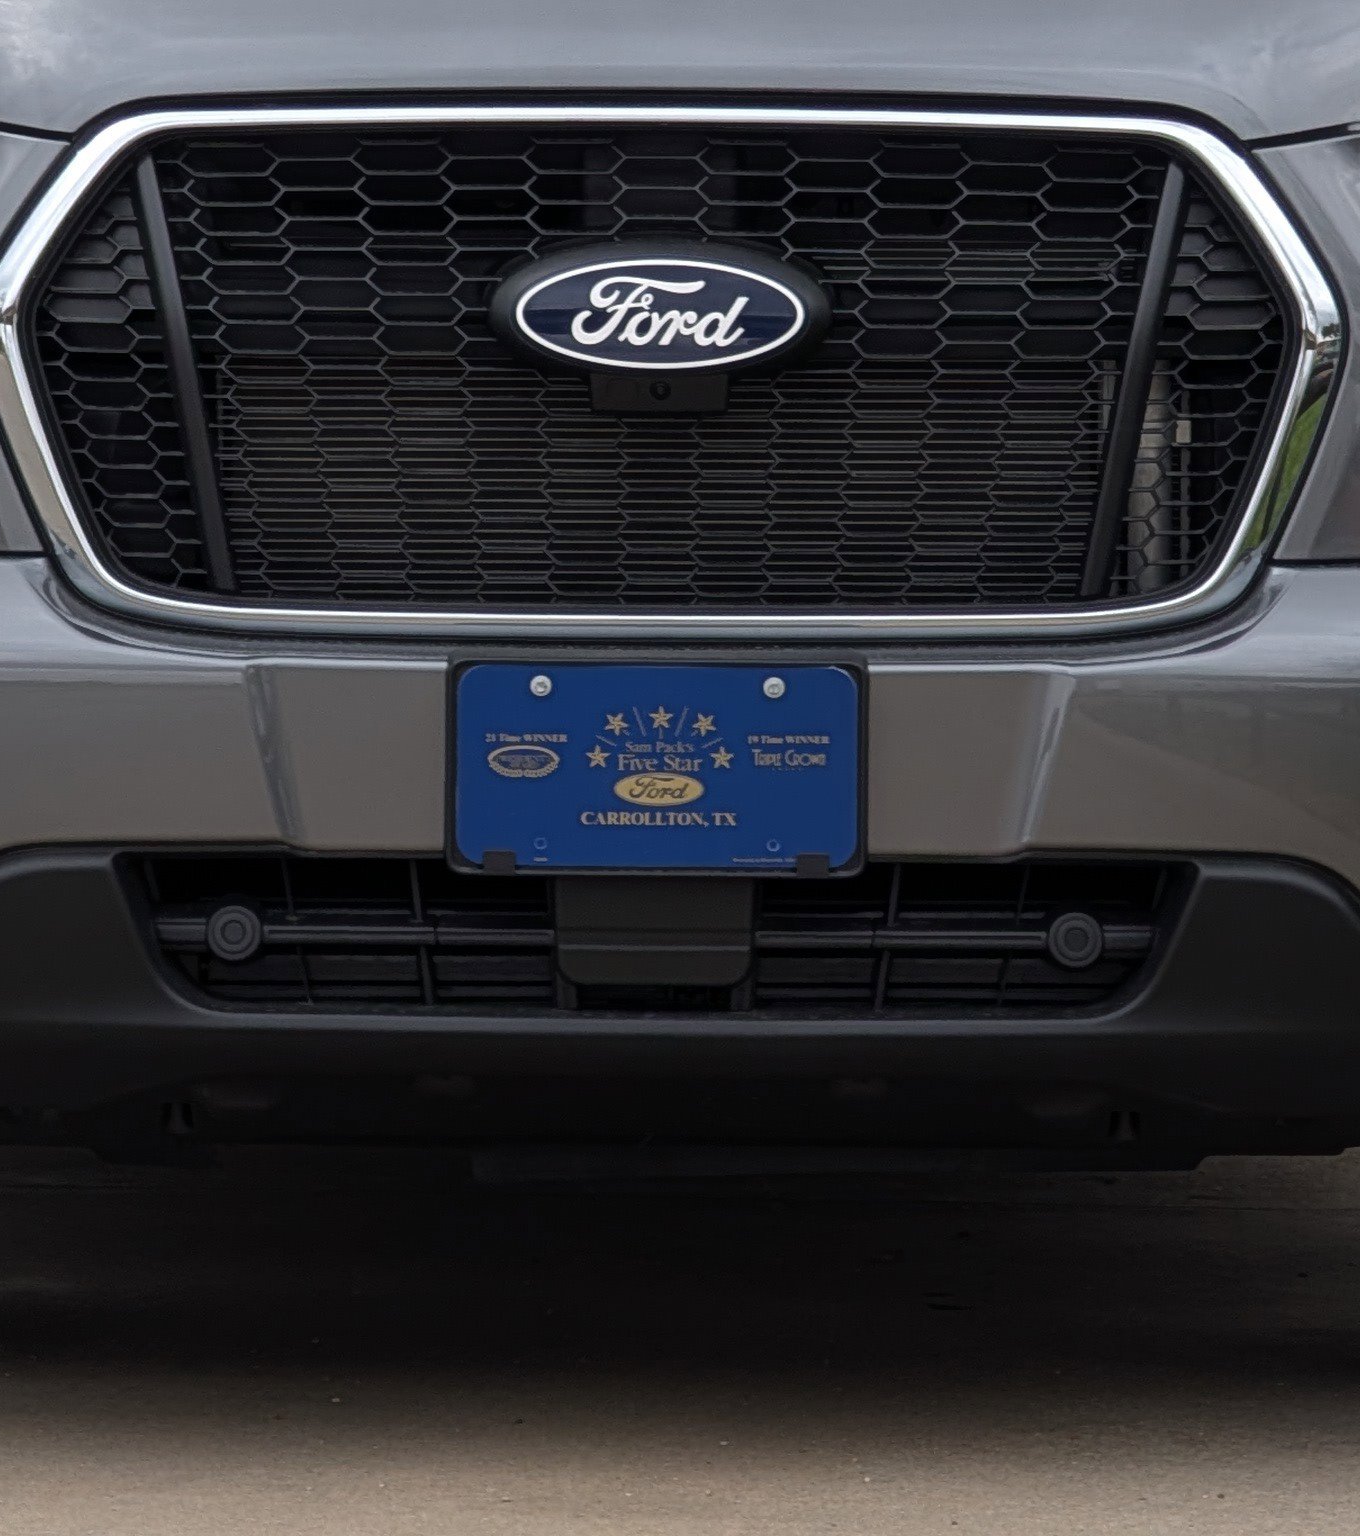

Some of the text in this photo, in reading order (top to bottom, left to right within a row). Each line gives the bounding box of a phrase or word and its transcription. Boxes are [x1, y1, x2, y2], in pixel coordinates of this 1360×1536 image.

[570, 275, 750, 348] Ford
[617, 753, 703, 771] Five Star
[628, 774, 689, 799] Ford
[580, 811, 738, 828] CARROLLTON, TX
